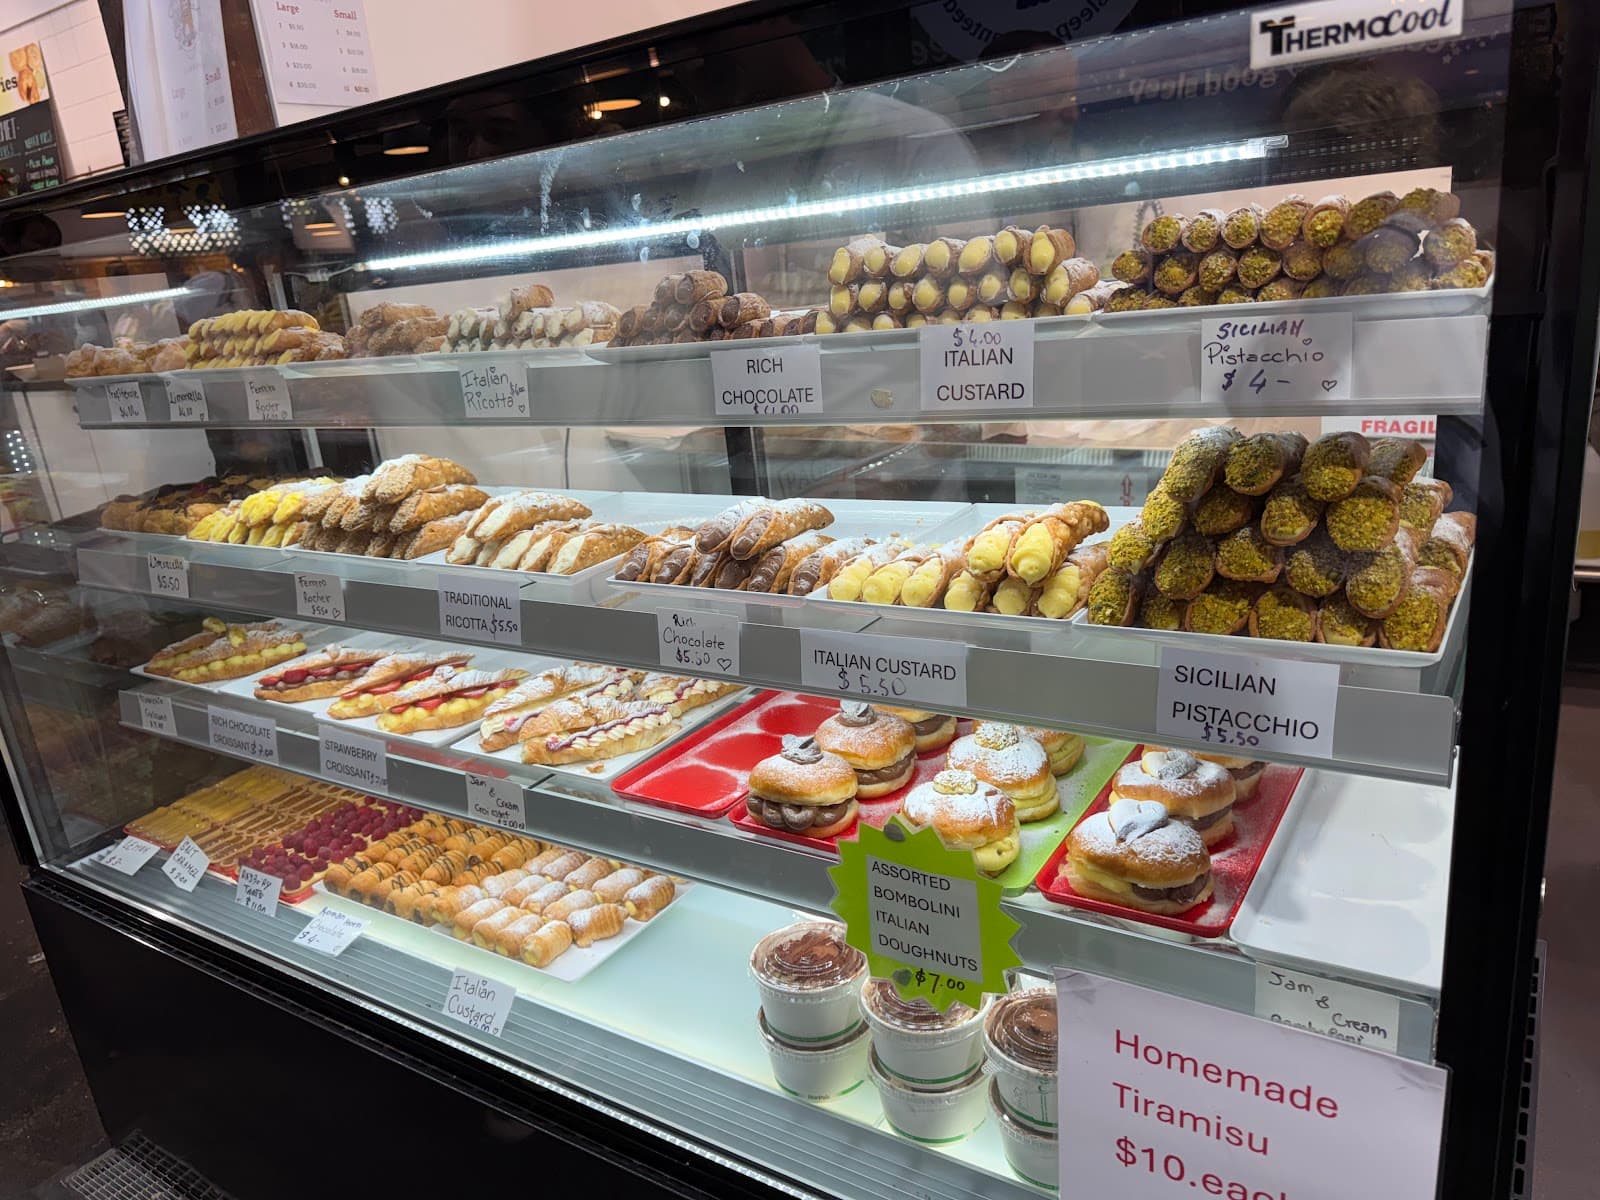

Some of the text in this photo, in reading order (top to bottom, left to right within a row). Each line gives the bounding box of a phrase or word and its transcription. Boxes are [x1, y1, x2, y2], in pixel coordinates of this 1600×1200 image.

[333, 9, 358, 21] Small
[1216, 319, 1305, 340] SICILIAN
[944, 347, 1013, 367] ITALIAN
[1203, 341, 1325, 366] Pistacchio
[461, 367, 510, 388] Italian
[746, 357, 783, 375] RICH
[464, 391, 514, 410] Ricotta
[722, 387, 814, 405] CHOCOLATE
[936, 382, 1025, 402] CUSTARD
[443, 590, 513, 611] TRADITIONAL
[445, 614, 489, 632] RICOTTA
[662, 626, 726, 651] Chocolate
[675, 646, 711, 666] $5.50
[813, 648, 957, 682] ITALIAN CUSTARD
[1173, 664, 1277, 697] SICILIAN
[228, 719, 272, 740] CHOCOLATE
[1171, 700, 1321, 741] PISTACCHIO
[324, 739, 378, 762] STRAWBERRY
[325, 758, 370, 781] CROISSANT
[871, 860, 952, 892] ASSORTED
[873, 884, 961, 919] BOMBOLINI
[875, 909, 930, 937] ITALIAN
[877, 933, 978, 972] DOUGHNUTS
[453, 974, 497, 1002] Italian
[914, 967, 966, 994] $7.00
[1268, 970, 1315, 994] Jam
[447, 993, 497, 1026] Custard
[1315, 994, 1331, 1010] &
[1331, 1012, 1388, 1040] Cream
[1113, 1028, 1341, 1120] Homemade
[1111, 1081, 1269, 1157] Tiramisu
